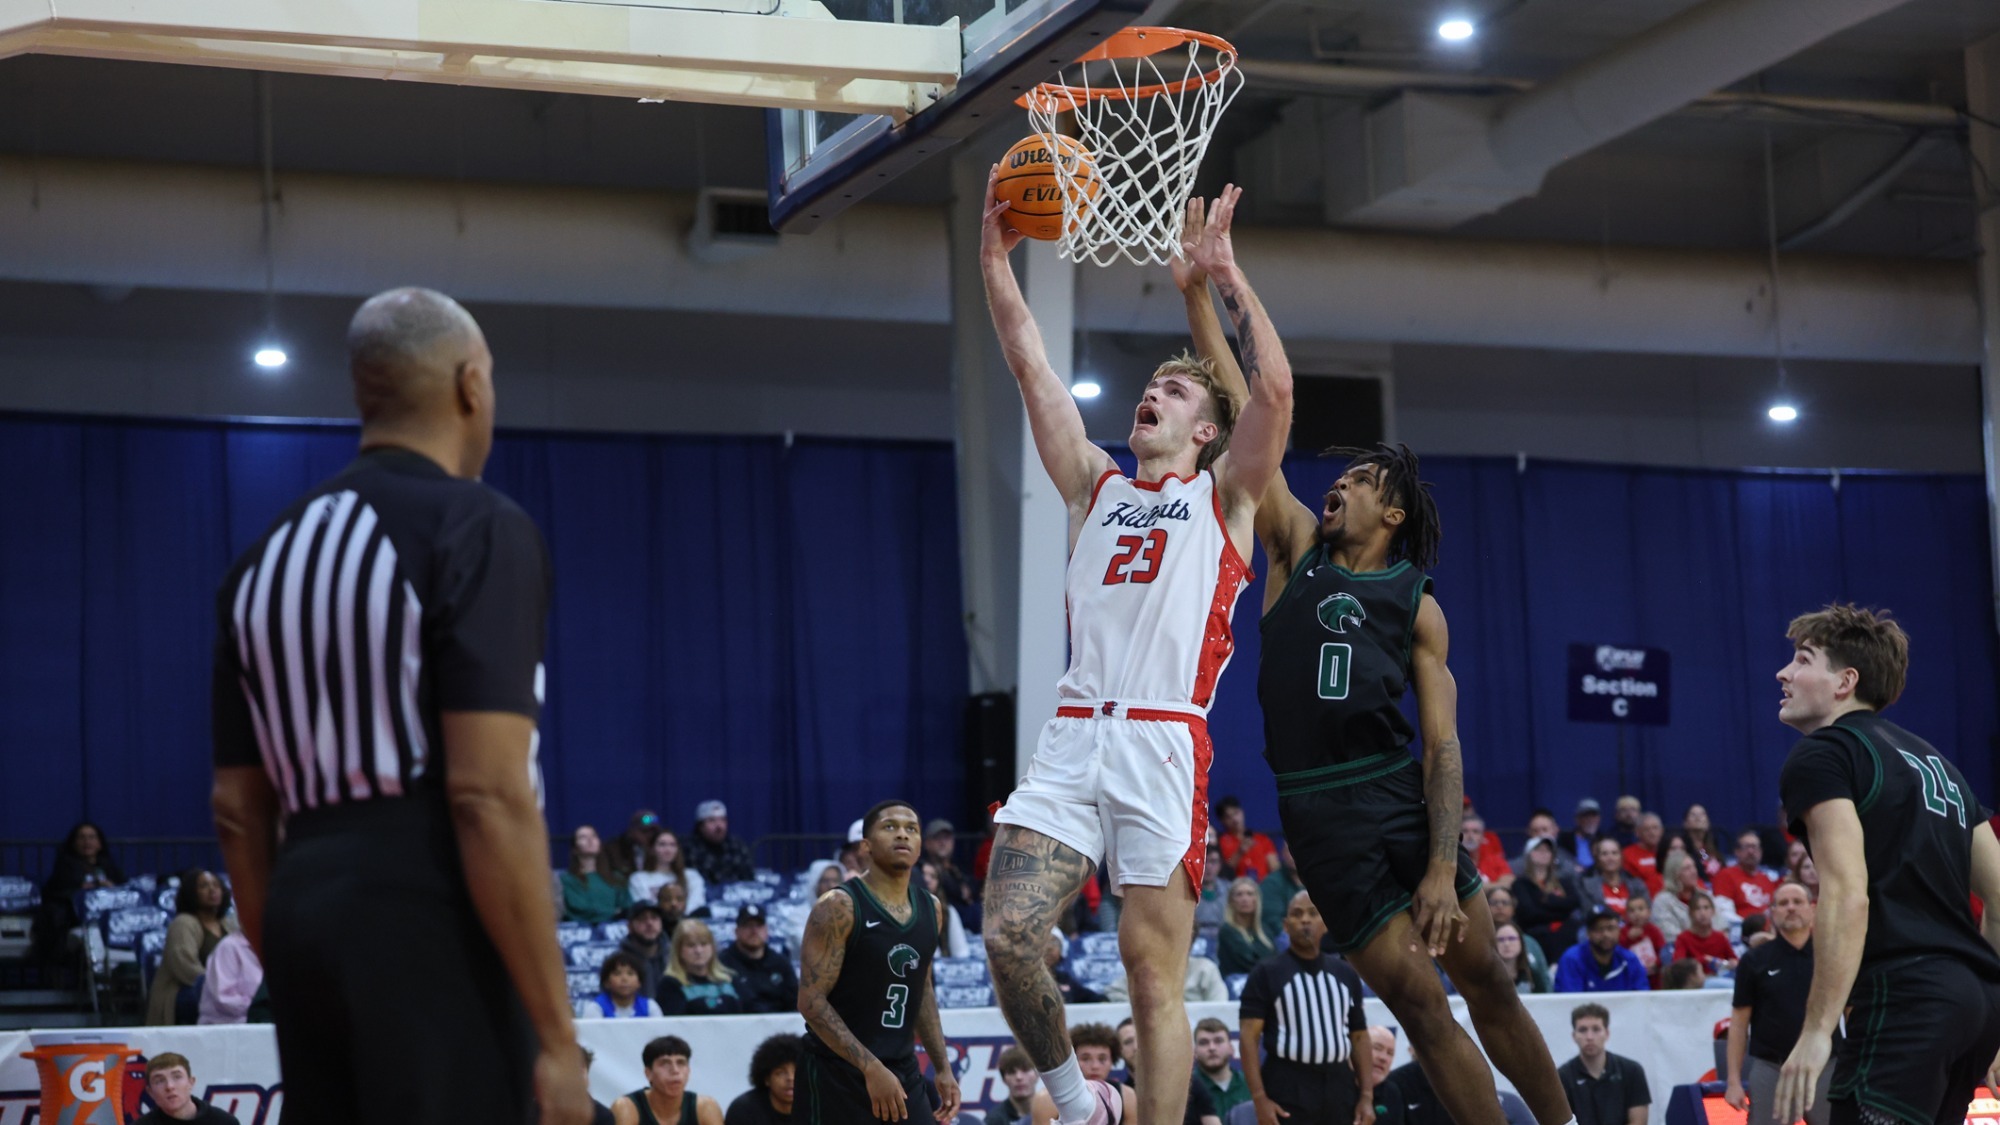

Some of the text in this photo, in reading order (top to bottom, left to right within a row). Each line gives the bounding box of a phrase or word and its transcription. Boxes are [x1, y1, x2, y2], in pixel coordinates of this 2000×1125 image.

[1102, 528, 1168, 585] 23
[1317, 642, 1352, 700] 0
[1581, 674, 1658, 697] Section
[1612, 697, 1629, 717] C
[1896, 748, 1967, 829] 24
[881, 984, 909, 1028] 3
[70, 1060, 106, 1102] G
